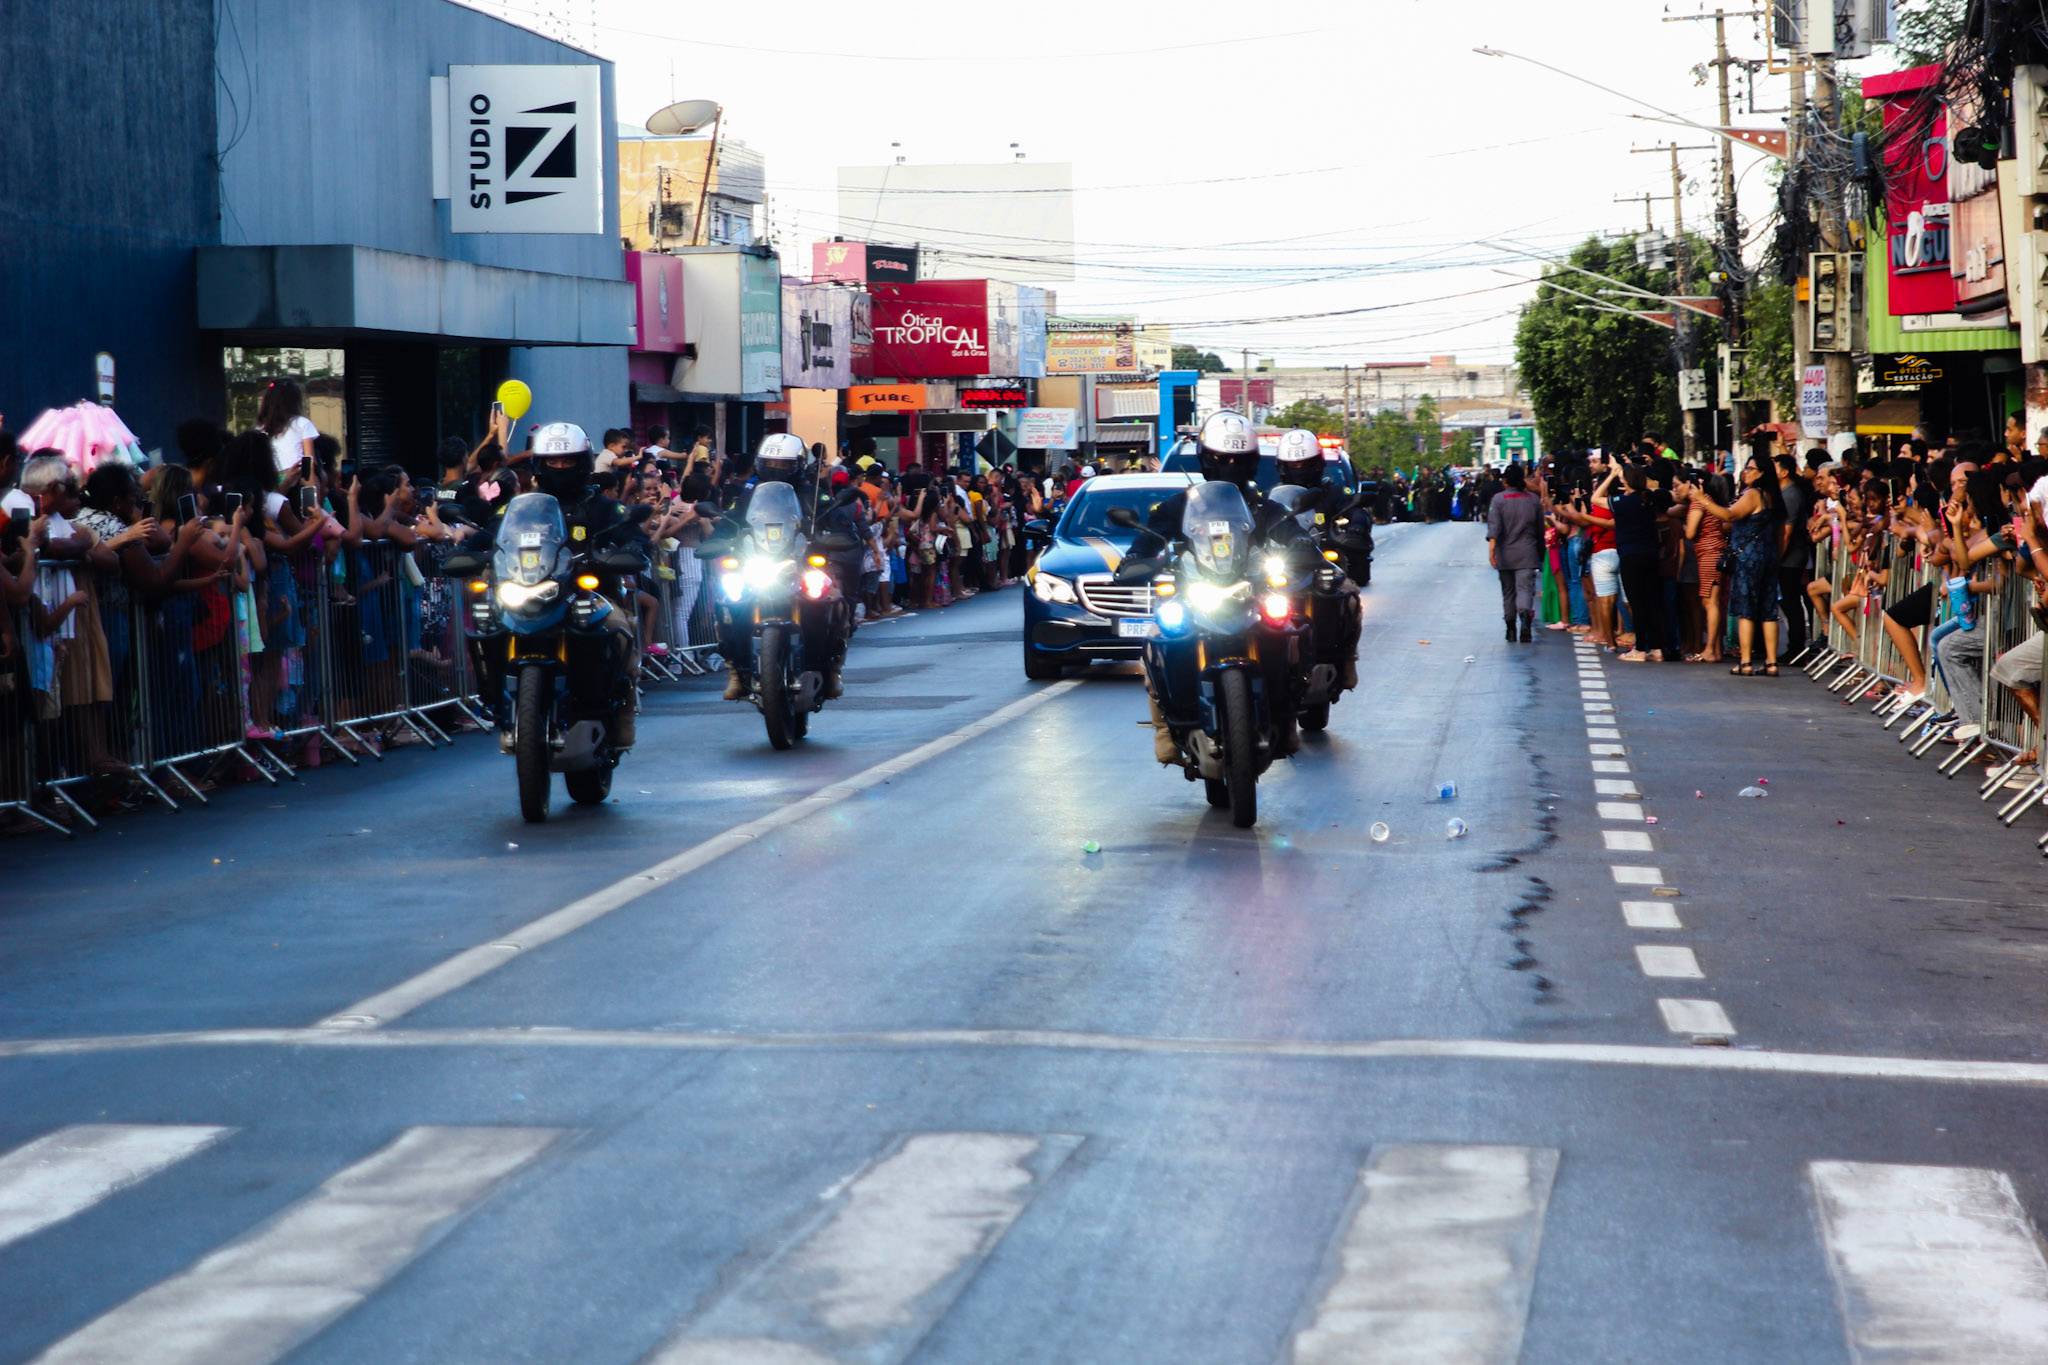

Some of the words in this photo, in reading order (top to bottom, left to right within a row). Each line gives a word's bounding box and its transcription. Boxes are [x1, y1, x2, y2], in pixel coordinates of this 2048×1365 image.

[470, 94, 491, 209] STUDIO
[901, 309, 943, 328] Ótica
[875, 326, 985, 349] TROPICAL
[1894, 373, 1934, 381] ESTAÇÃO
[859, 393, 914, 404] TUBE
[545, 441, 571, 451] PRF
[1223, 440, 1248, 449] PRF
